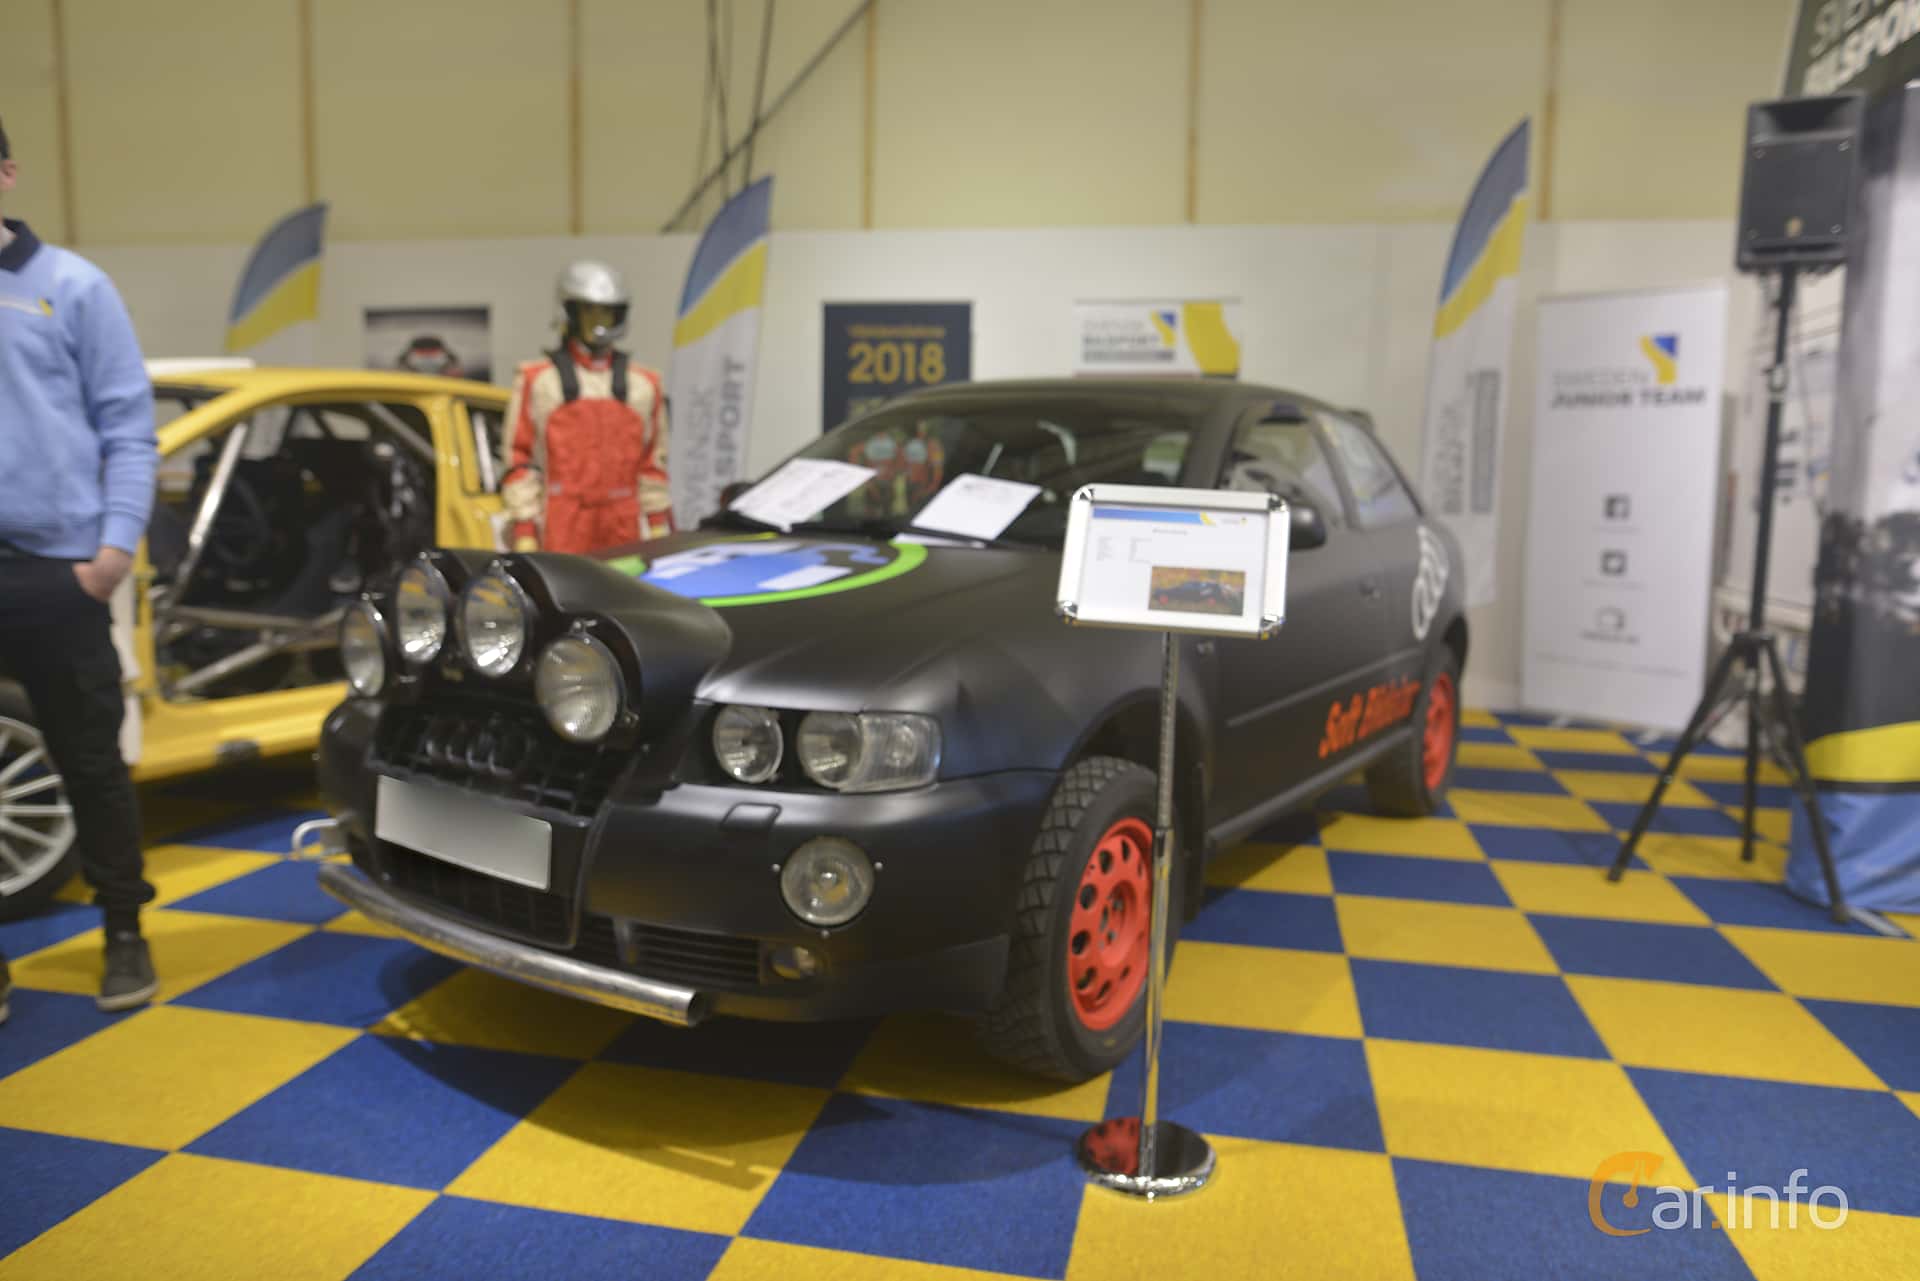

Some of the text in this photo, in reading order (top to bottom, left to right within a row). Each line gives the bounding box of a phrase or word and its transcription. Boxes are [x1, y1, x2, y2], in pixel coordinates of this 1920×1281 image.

[848, 341, 945, 384] 2018
[1552, 387, 1706, 408] JUNIOR TEAM
